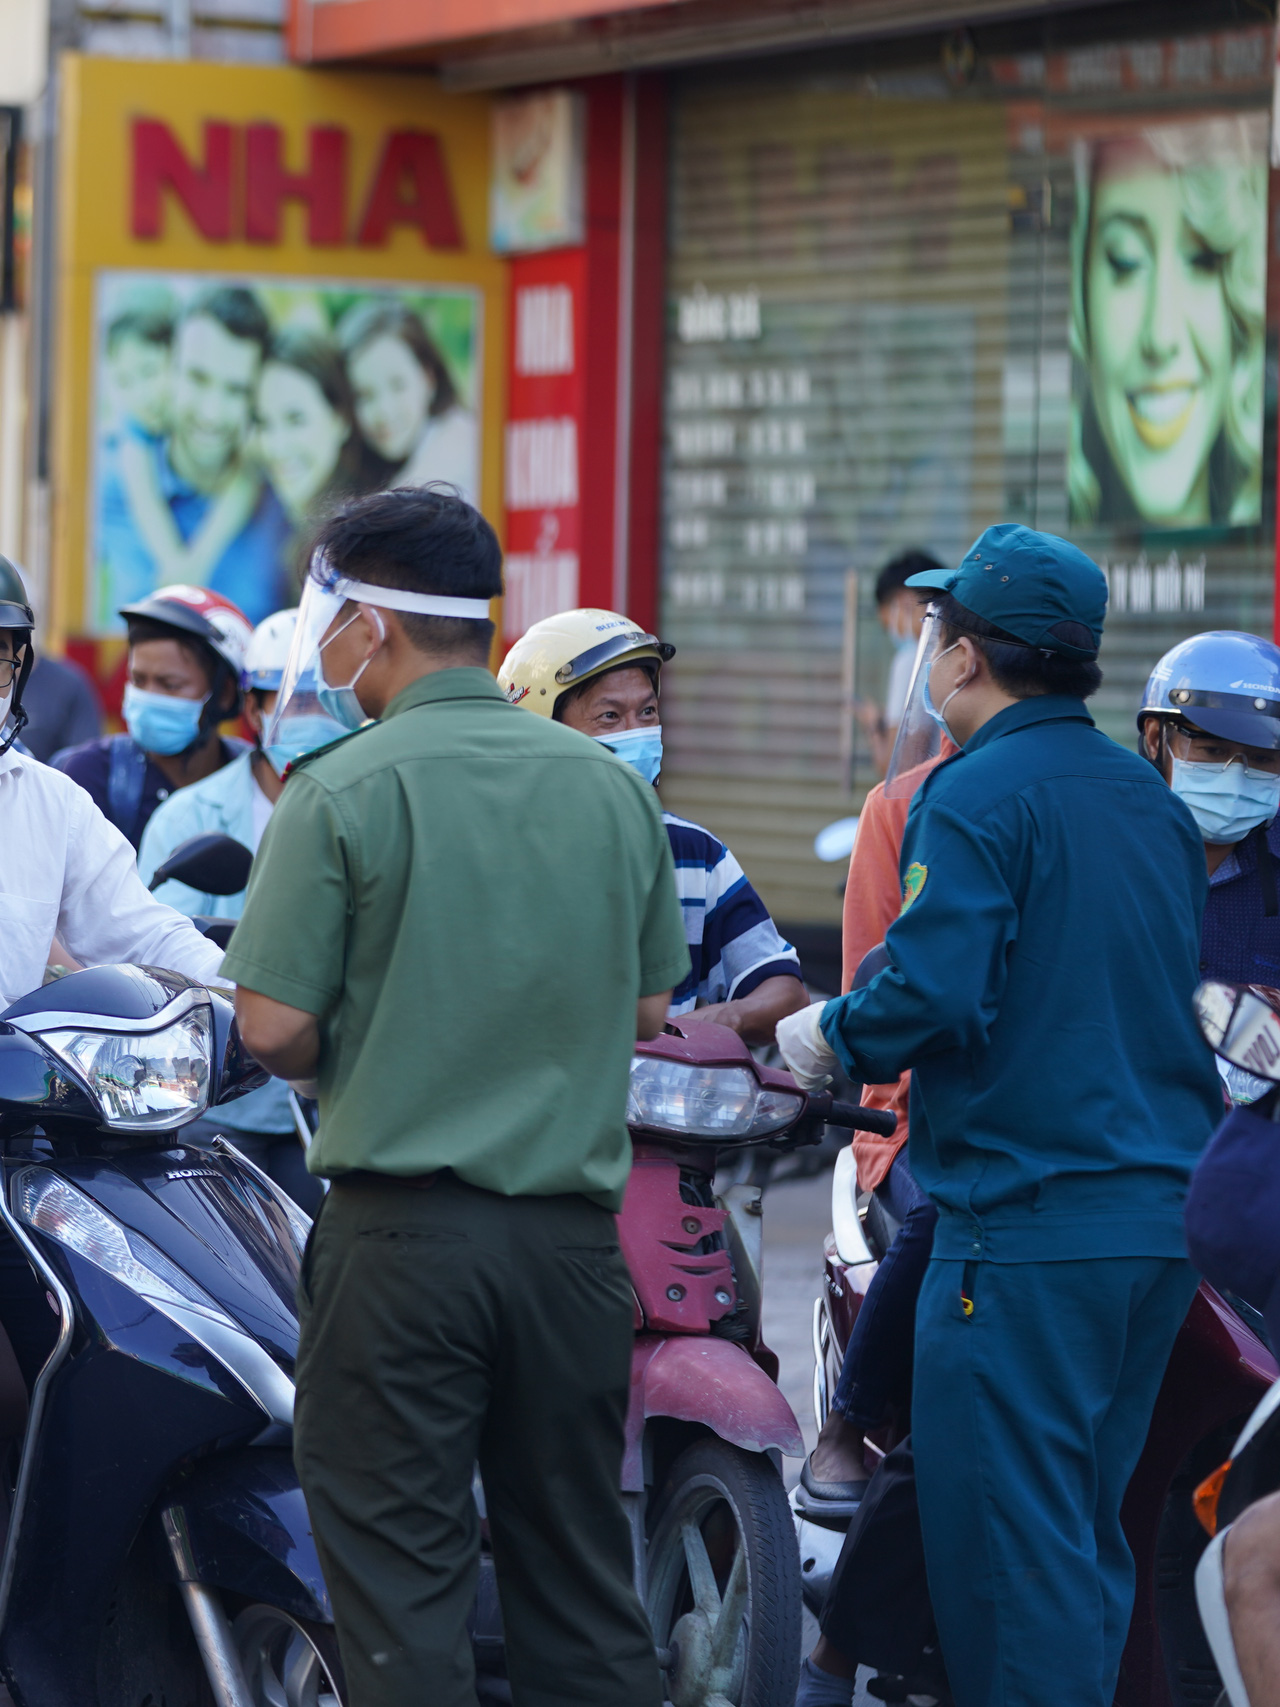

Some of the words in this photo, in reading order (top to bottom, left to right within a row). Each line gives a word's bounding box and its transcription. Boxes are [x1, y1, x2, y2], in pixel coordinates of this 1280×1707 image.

[129, 116, 470, 253] NHA
[1242, 682, 1280, 695] HONDA
[166, 1168, 223, 1179] HONDA
